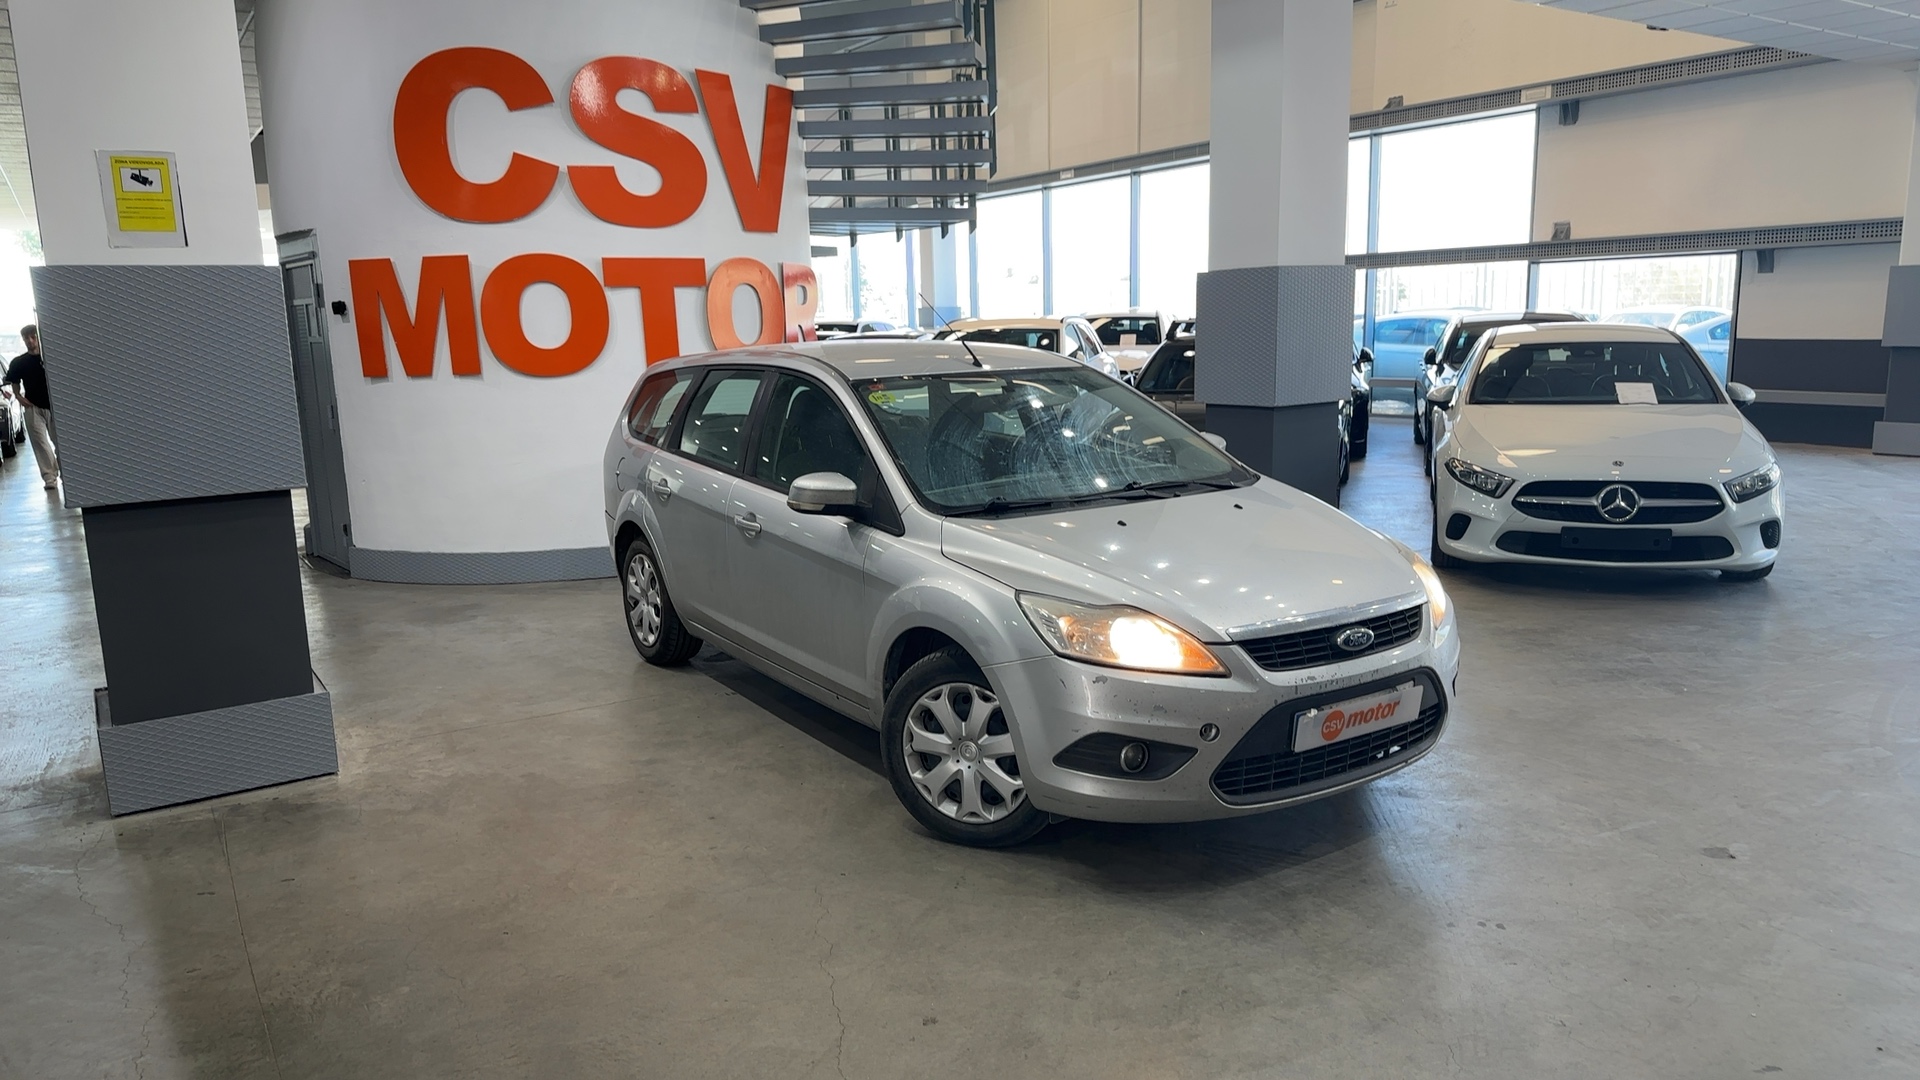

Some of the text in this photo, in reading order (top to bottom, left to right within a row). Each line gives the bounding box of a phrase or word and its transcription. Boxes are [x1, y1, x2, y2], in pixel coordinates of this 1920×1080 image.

[394, 46, 795, 233] CSV
[348, 252, 819, 378] MOTOR
[1349, 632, 1367, 646] Ford
[1322, 700, 1401, 733] CSV motor
